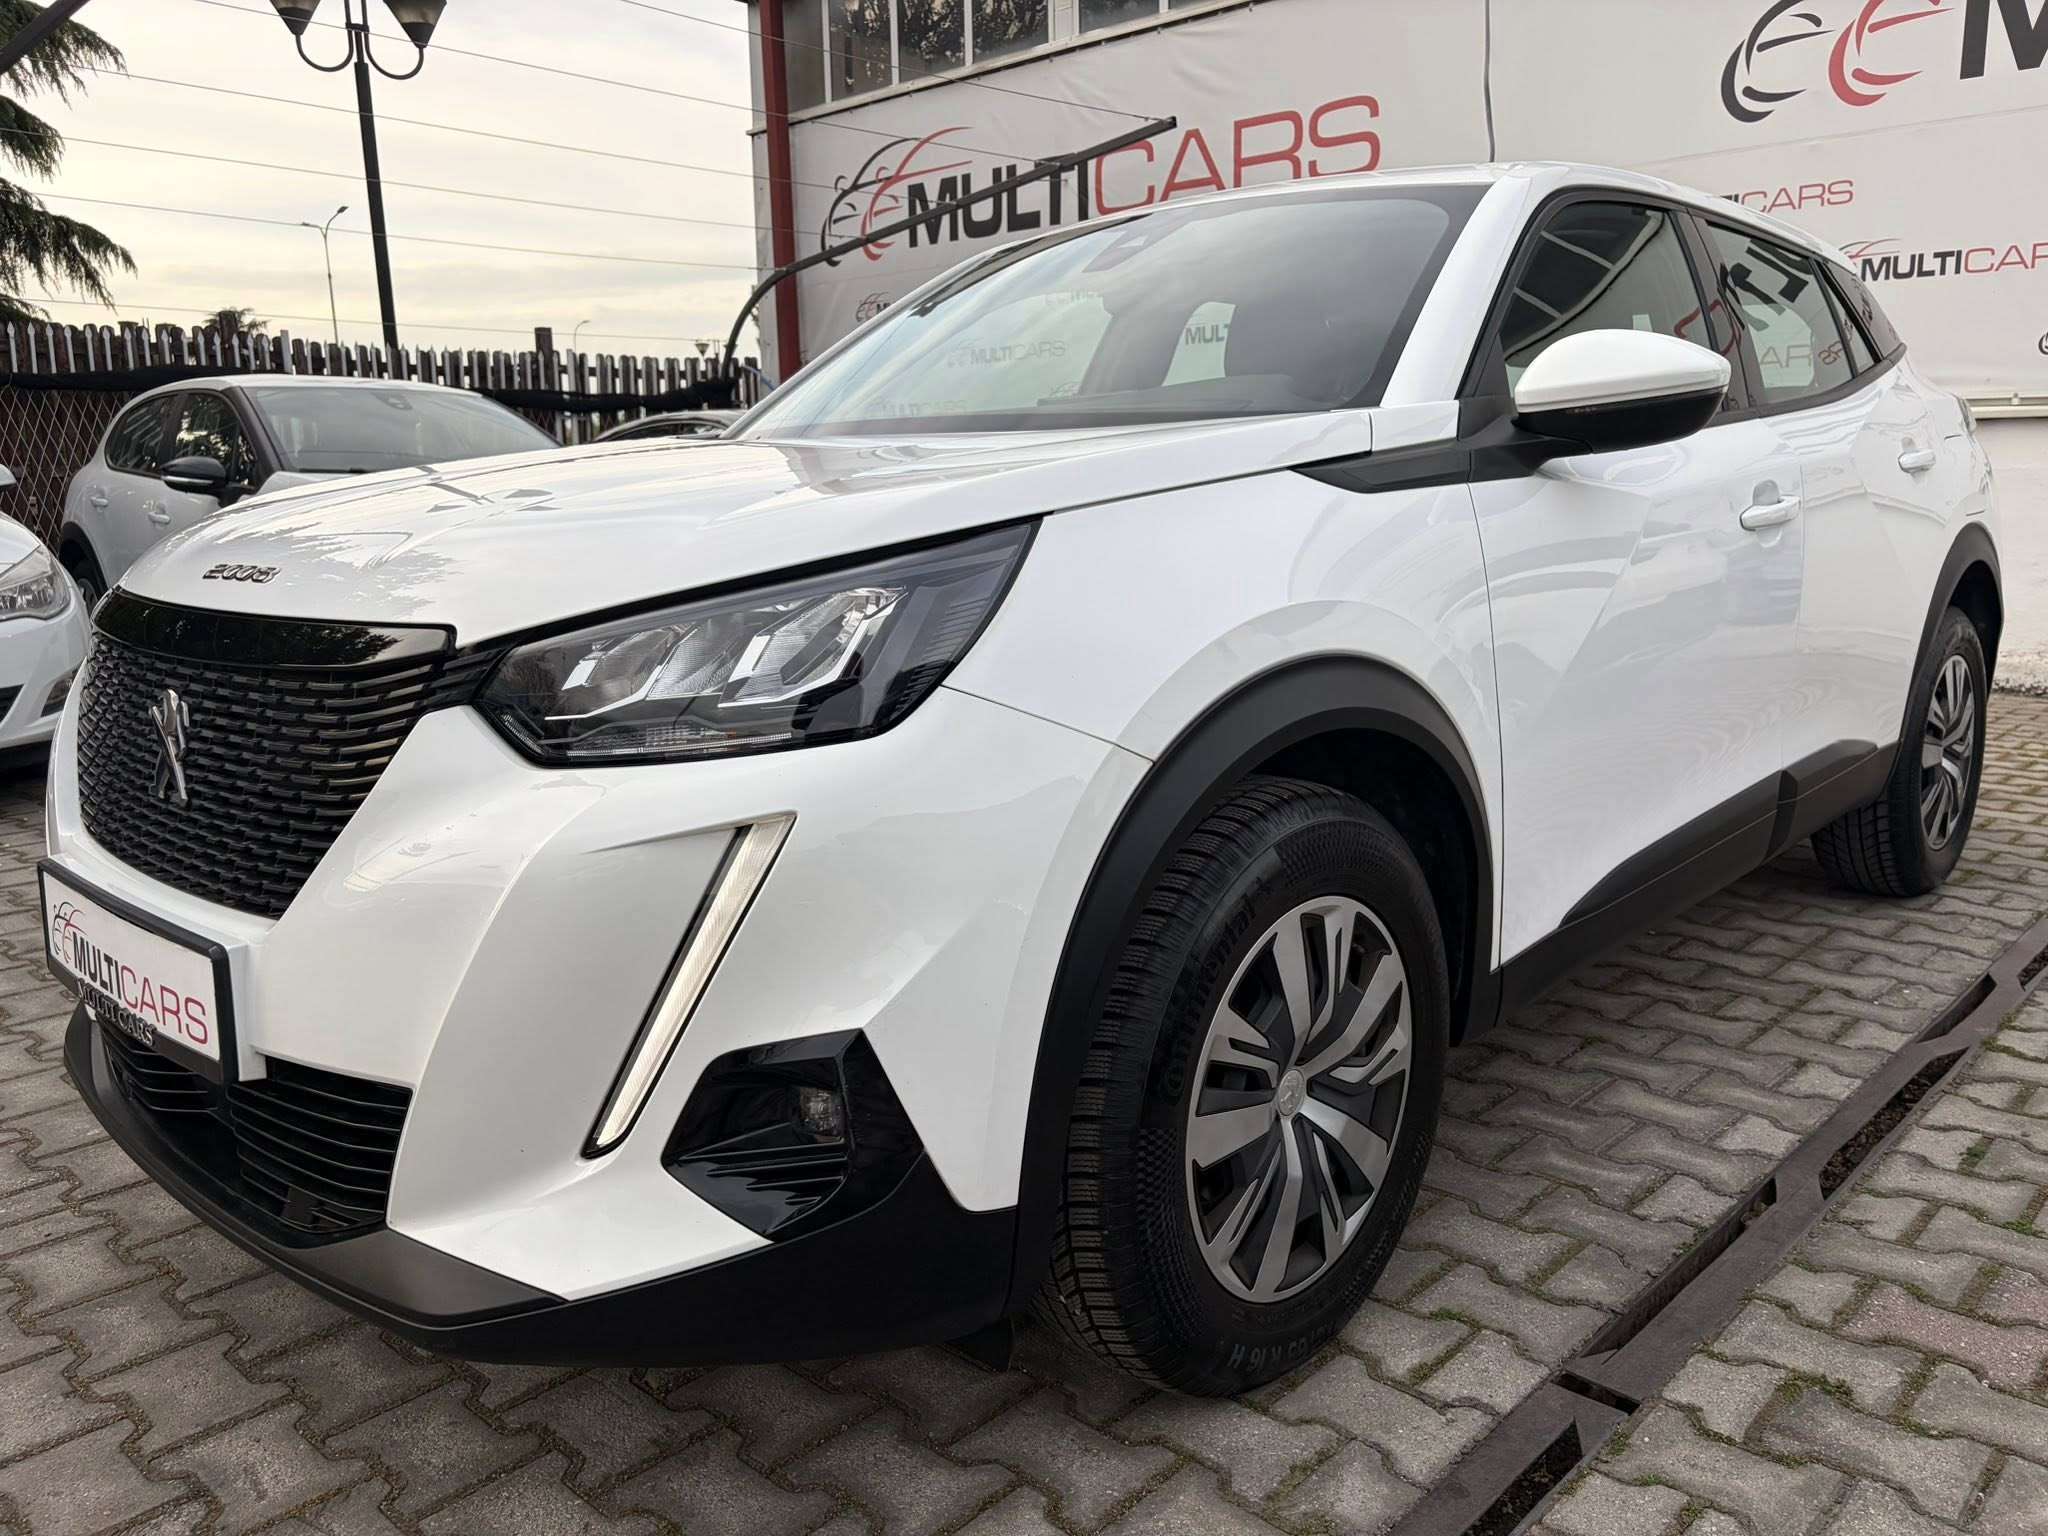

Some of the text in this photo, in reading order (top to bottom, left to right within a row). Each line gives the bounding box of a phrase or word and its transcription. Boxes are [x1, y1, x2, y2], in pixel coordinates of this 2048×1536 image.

[907, 94, 1381, 249] MULTICARS
[203, 563, 281, 584] 2008
[72, 931, 208, 1045] MULTICARS
